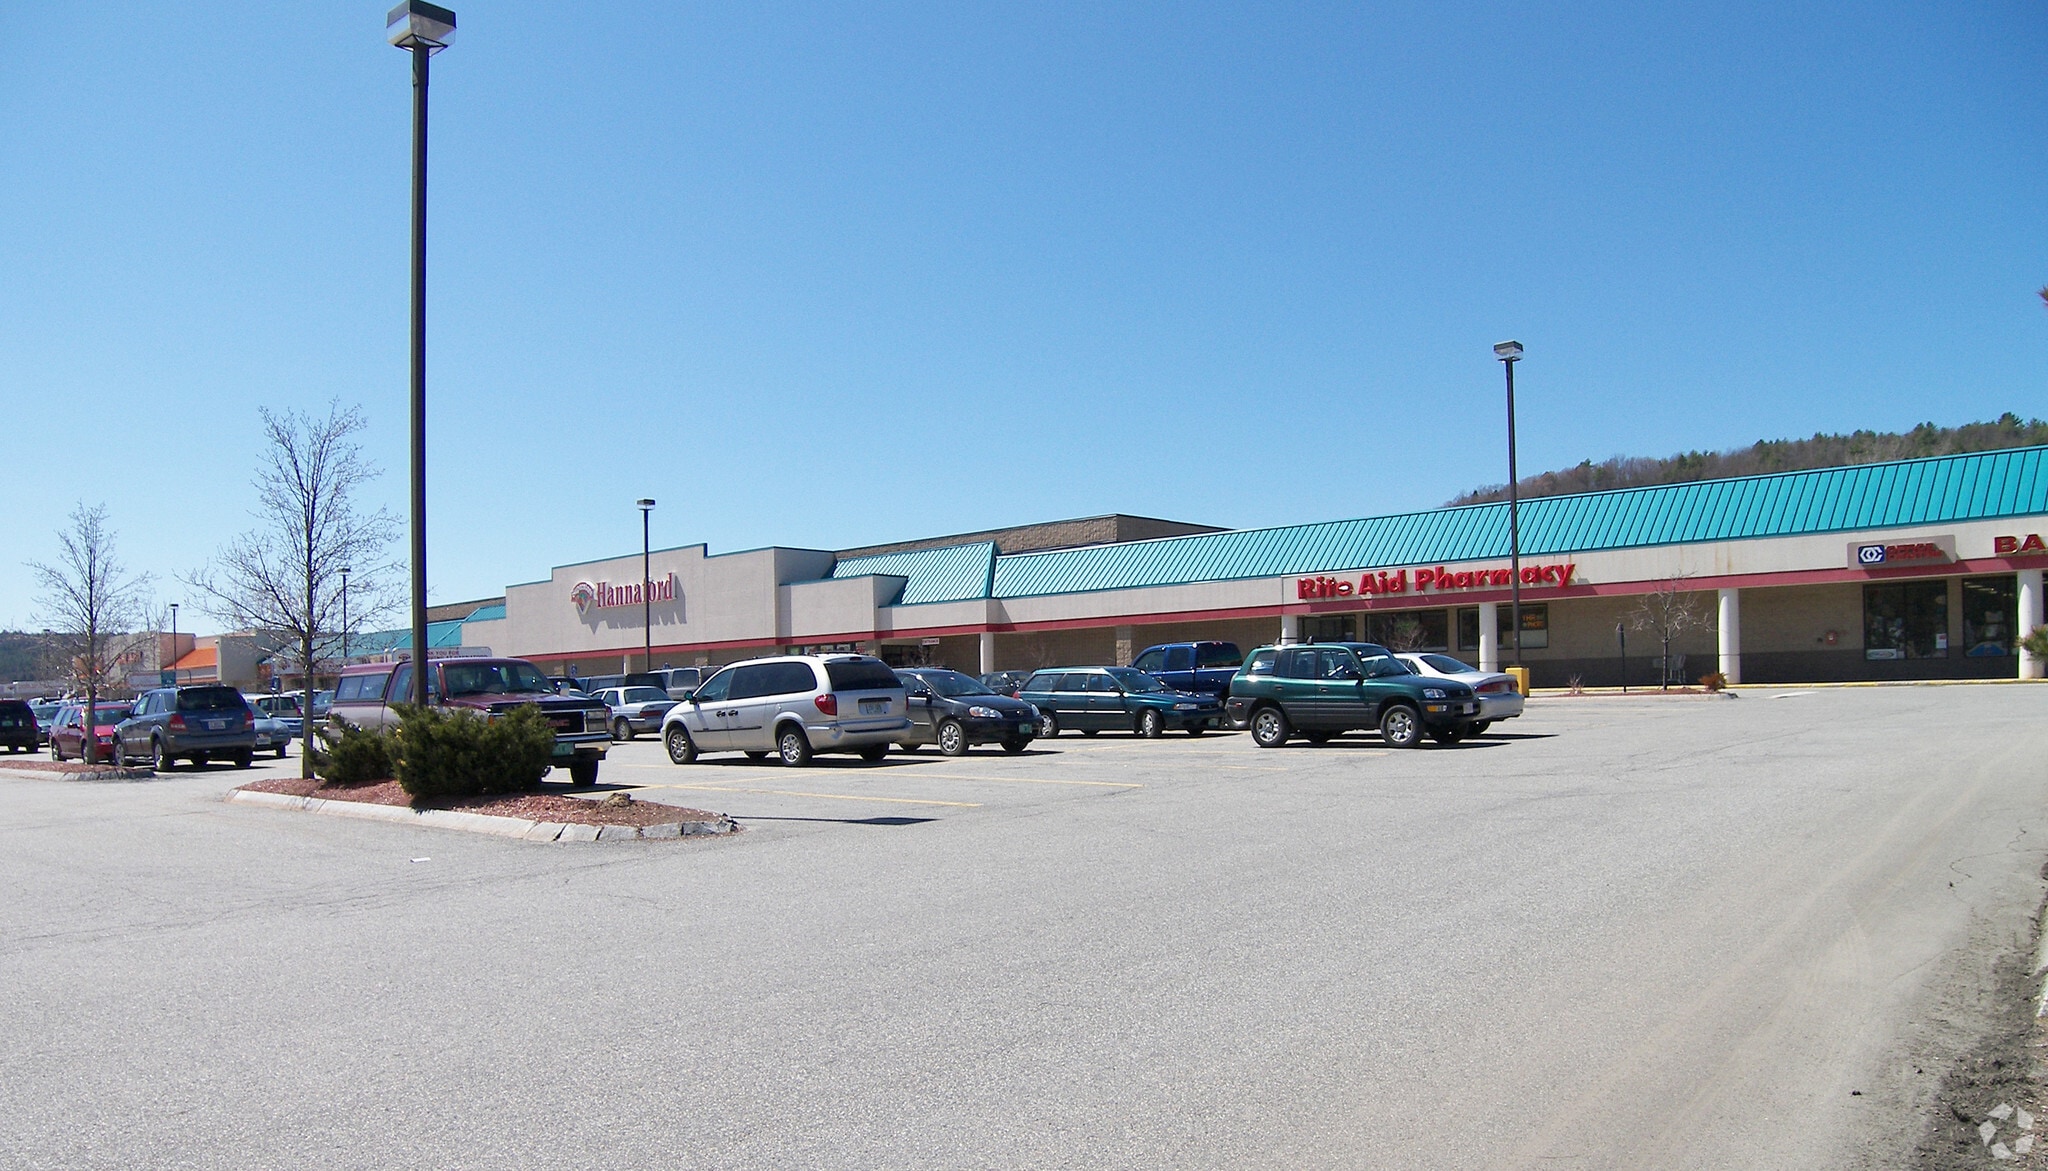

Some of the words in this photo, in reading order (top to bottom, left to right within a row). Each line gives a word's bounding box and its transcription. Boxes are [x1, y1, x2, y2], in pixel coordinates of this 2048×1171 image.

[596, 572, 673, 608] Hannaford
[1297, 576, 1353, 600] Rite
[1358, 569, 1406, 595] Aid
[1414, 564, 1575, 592] Pharmacy
